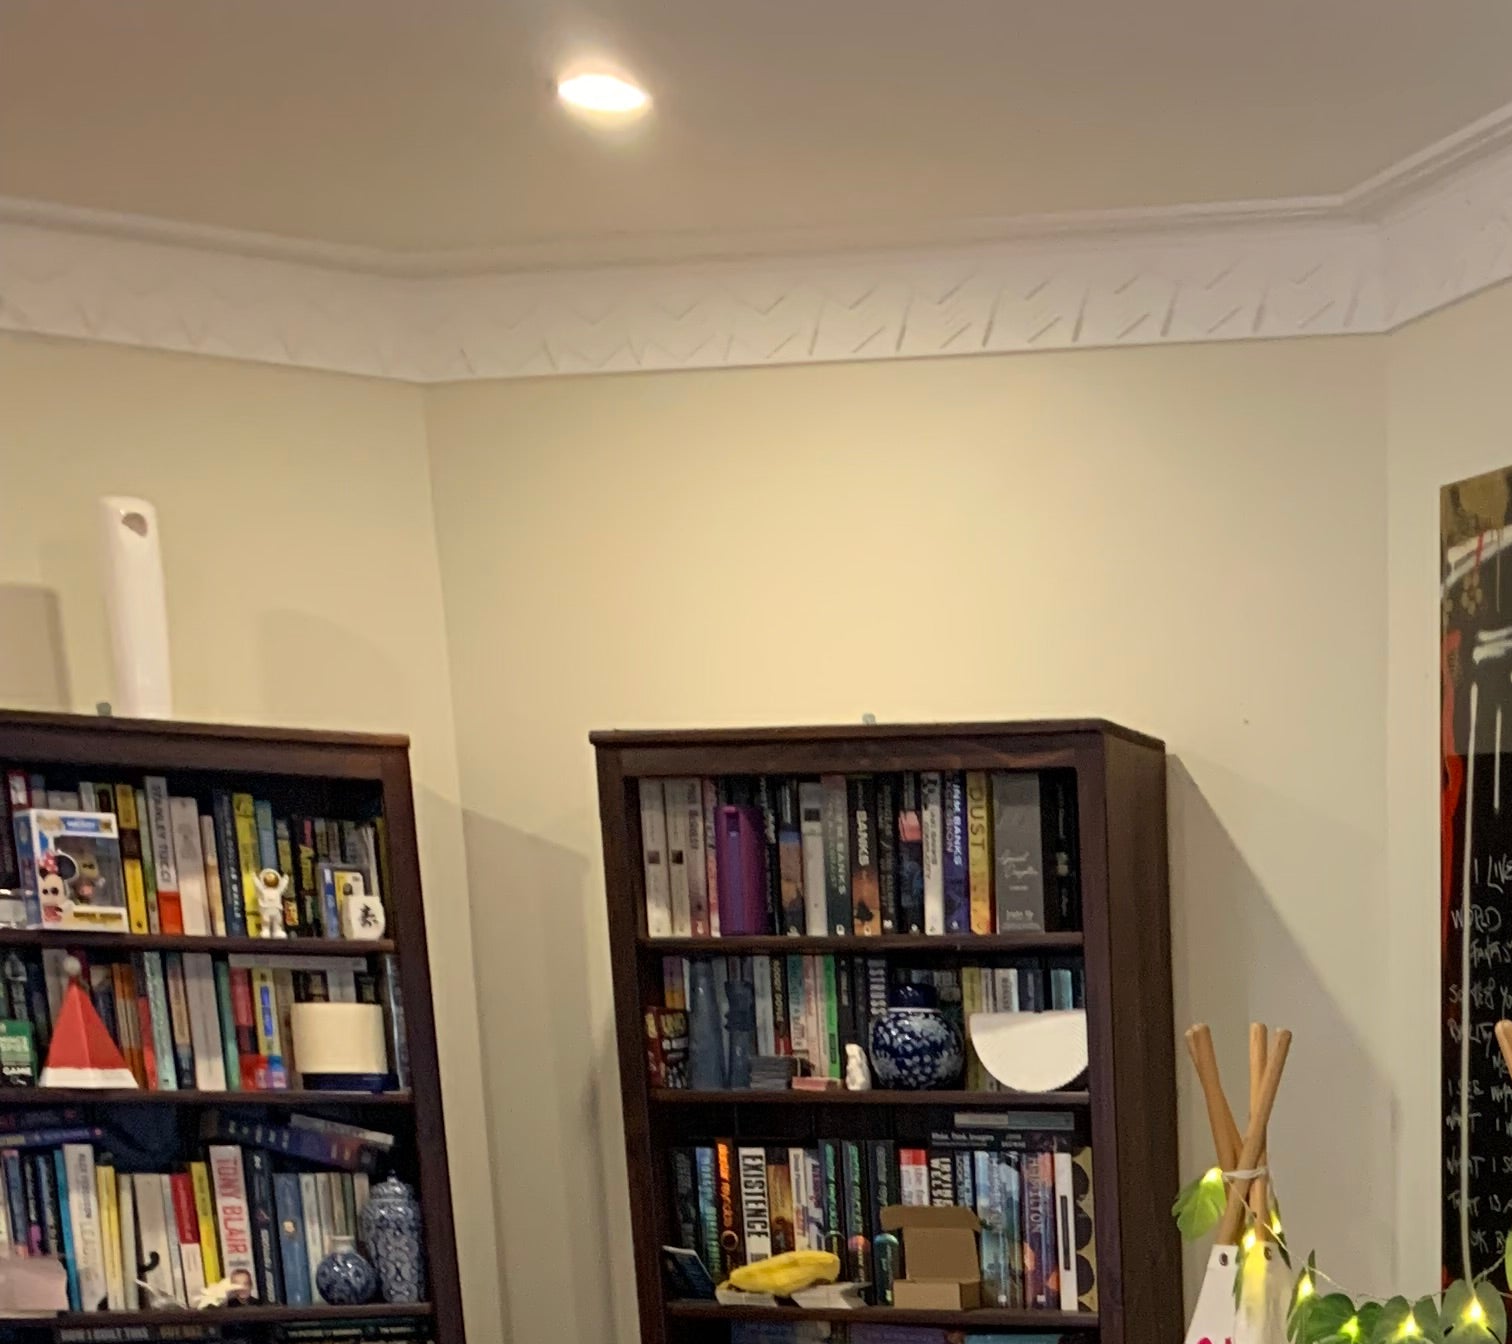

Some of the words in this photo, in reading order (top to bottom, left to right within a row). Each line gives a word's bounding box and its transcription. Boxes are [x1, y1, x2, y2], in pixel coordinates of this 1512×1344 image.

[969, 786, 985, 851] DUST
[216, 1157, 239, 1199] TONY
[742, 1154, 768, 1238] EXISTENCE
[223, 1205, 249, 1255] BLAIR
